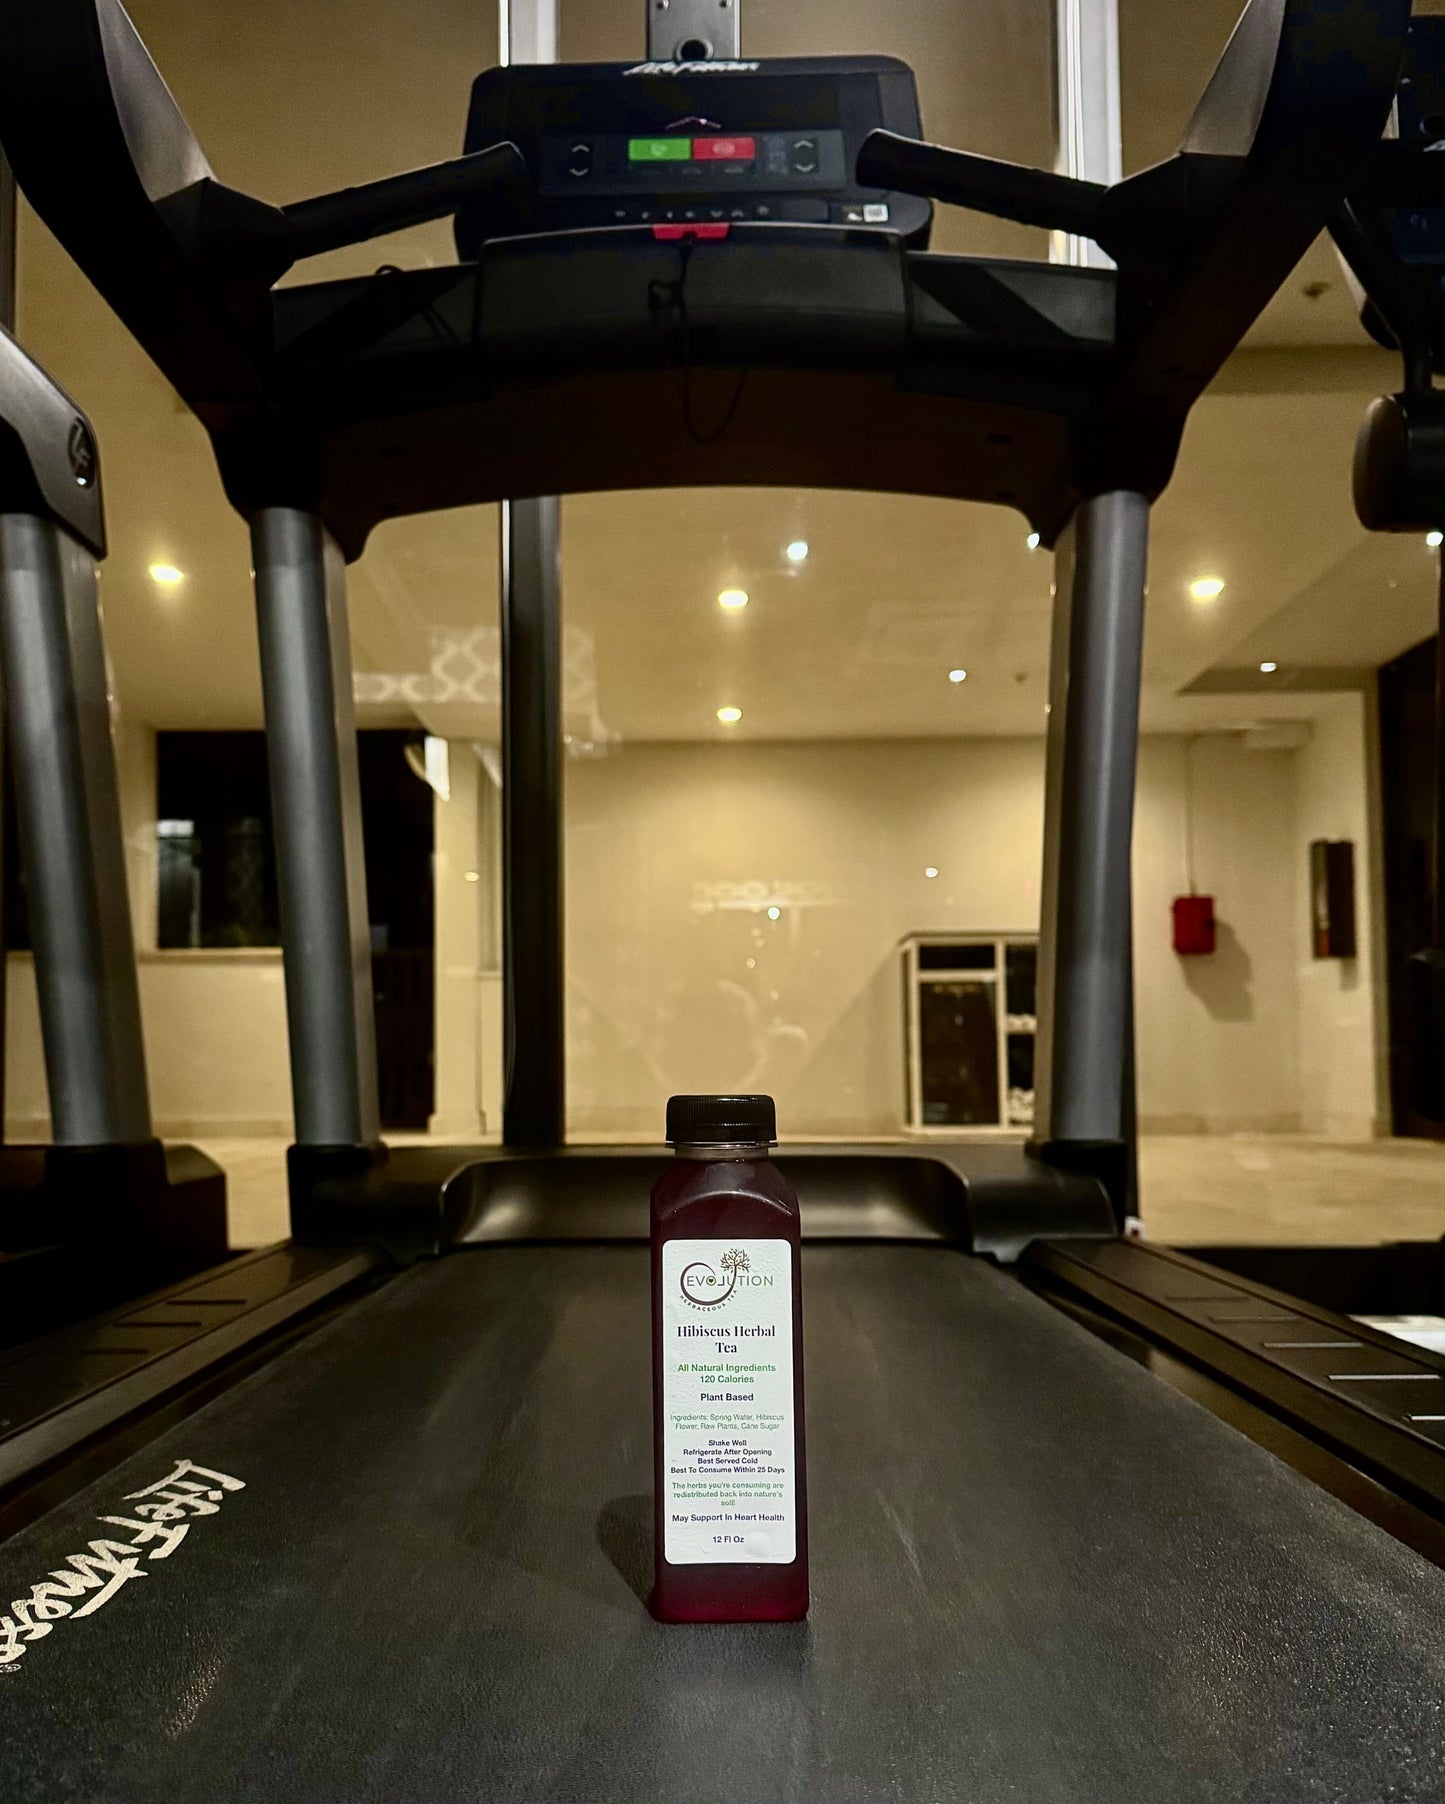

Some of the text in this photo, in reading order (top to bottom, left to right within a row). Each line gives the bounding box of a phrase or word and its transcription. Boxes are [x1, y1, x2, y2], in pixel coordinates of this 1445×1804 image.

[677, 1325, 776, 1337] Hibiscus Herbal
[715, 1342, 737, 1354] Tea
[677, 1363, 776, 1374] All Natural Ingredients
[699, 1374, 755, 1384] 120 Calories
[700, 1392, 754, 1402] Plant Based
[670, 1413, 785, 1422] Ingredients: Spring Water, Hibiscus
[675, 1422, 780, 1431] Flower, Raw Plants, Cane Sugar
[708, 1439, 747, 1447] Shake Well
[683, 1448, 773, 1457] Refrigerate After Opening
[697, 1457, 759, 1465] Best Served Cold
[670, 1466, 786, 1475] Best To Consume Within 25 Days
[672, 1482, 686, 1490] The
[686, 1482, 707, 1490] herbs
[708, 1482, 731, 1490] you're
[732, 1482, 771, 1490] consuming
[673, 1490, 783, 1498] redistributed back into nature's
[671, 1513, 785, 1524] May Support In Heart Health
[712, 1535, 723, 1544] 12
[732, 1535, 745, 1544] Oz
